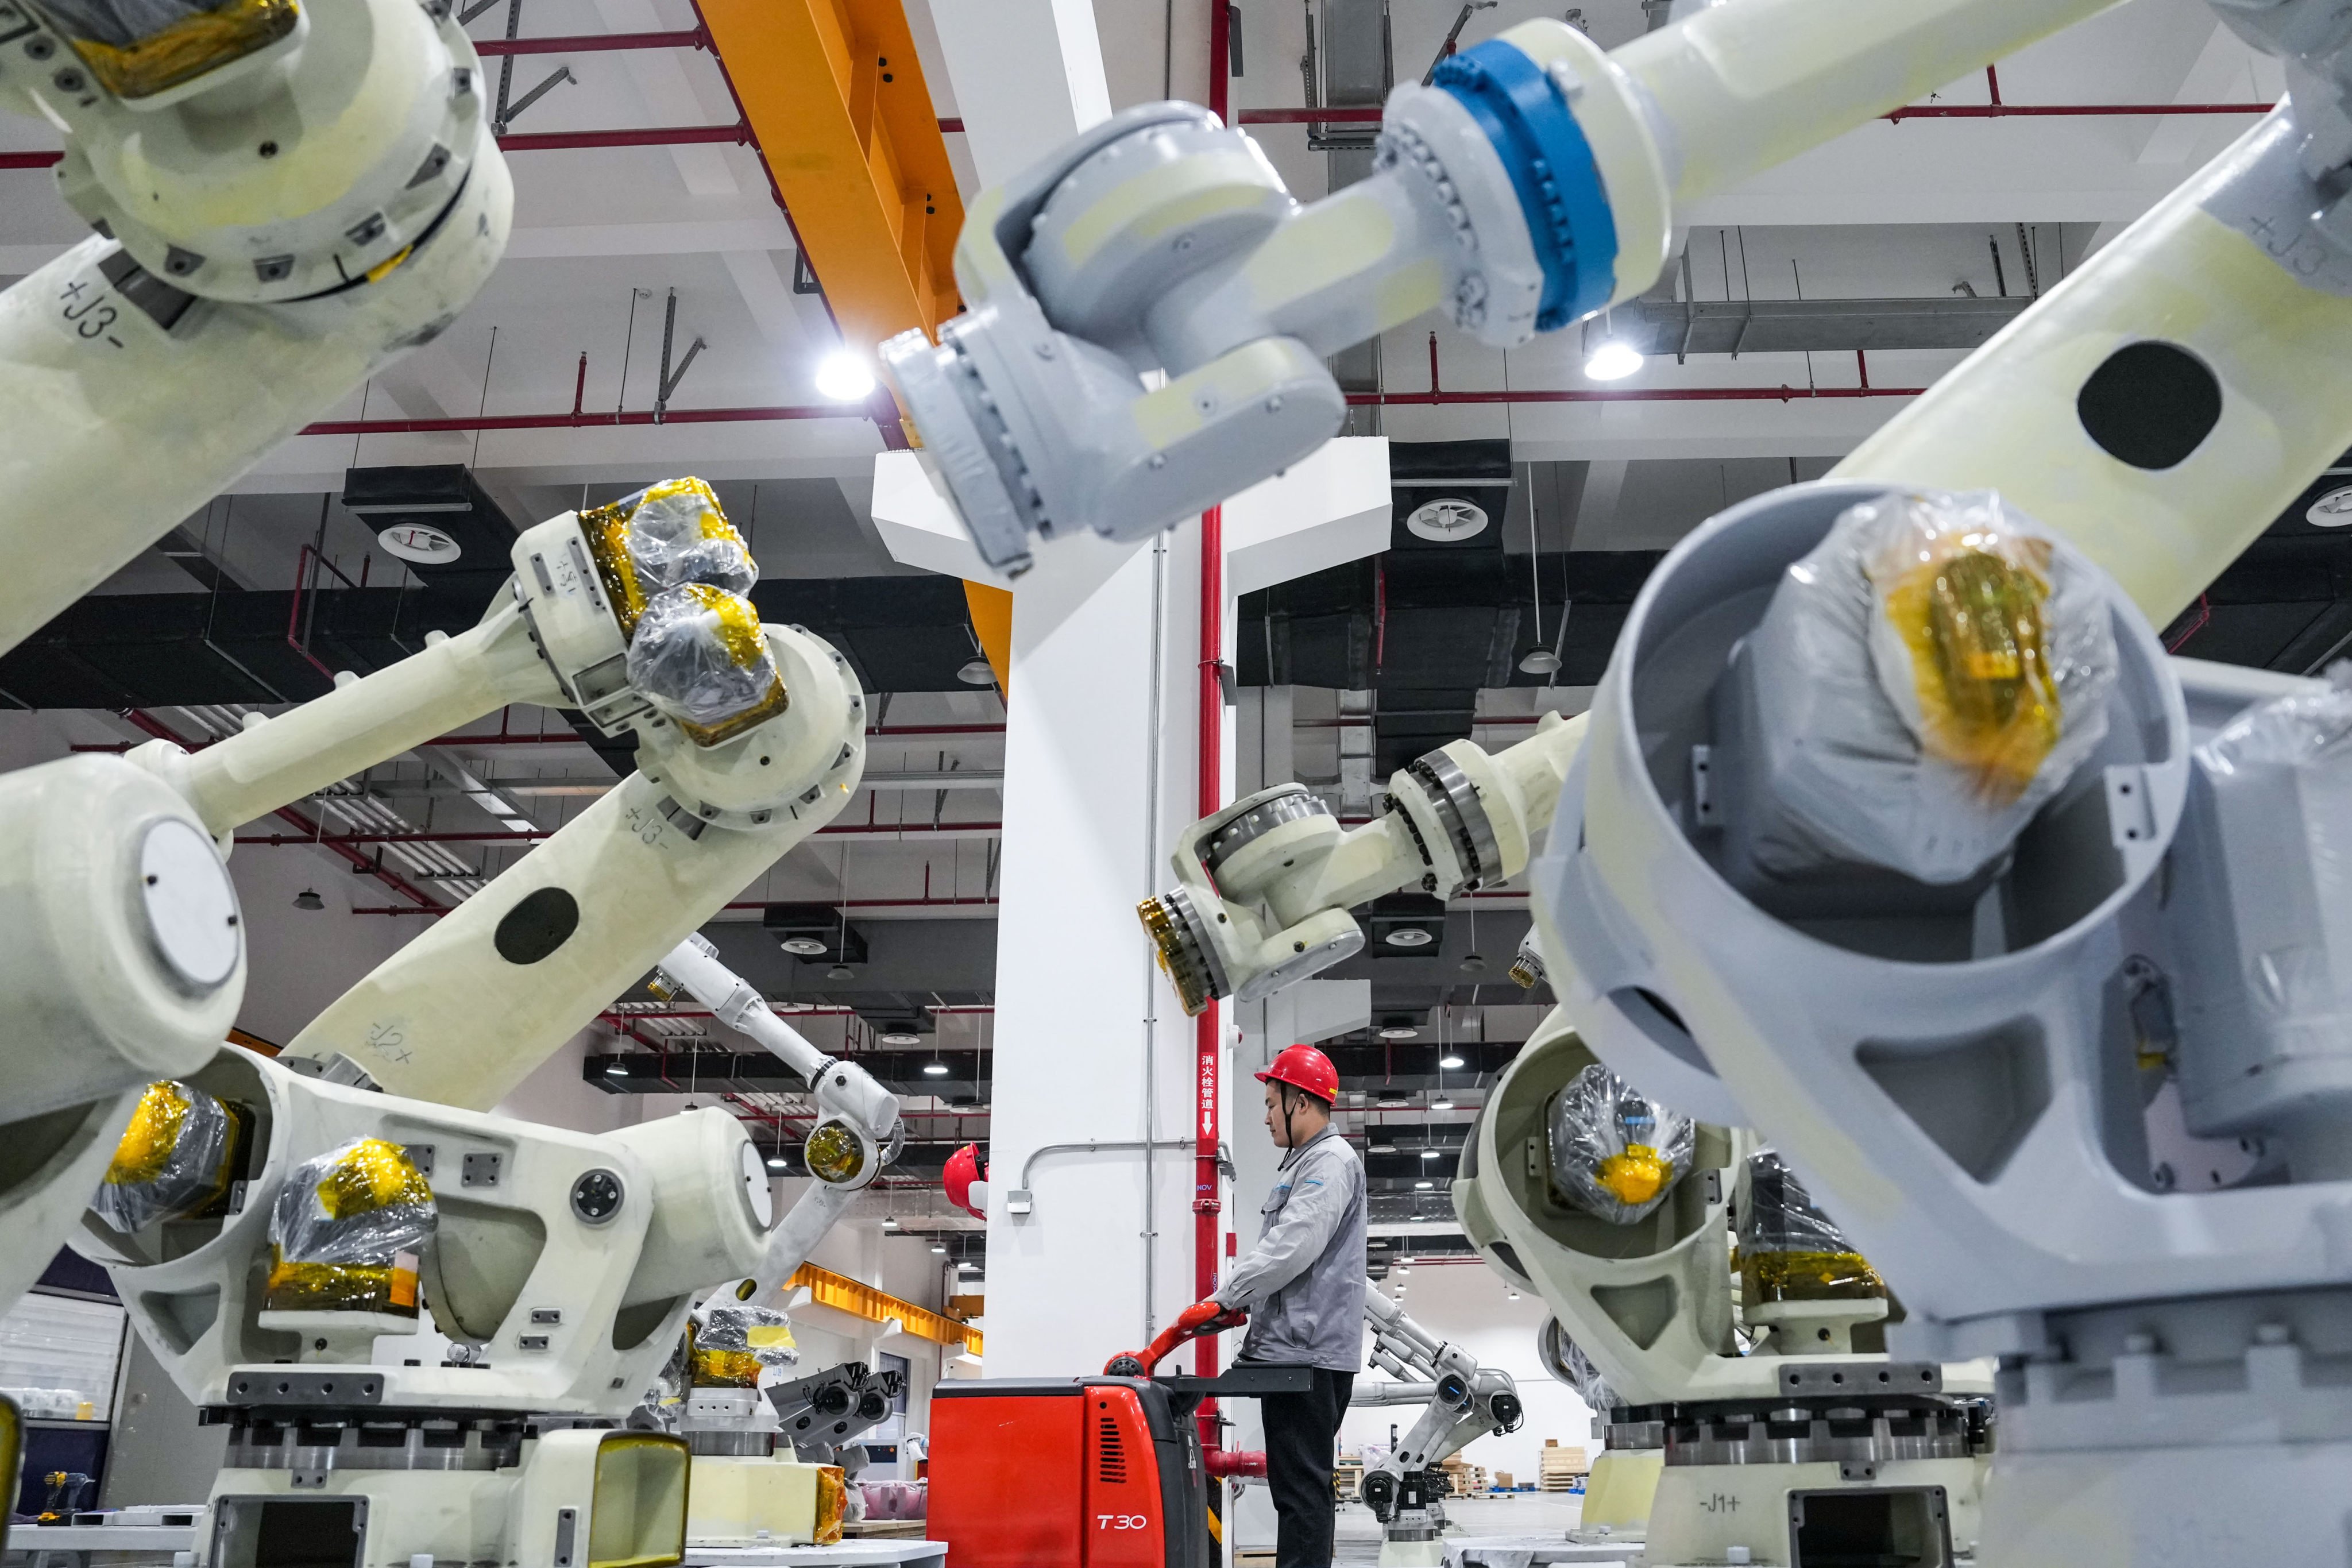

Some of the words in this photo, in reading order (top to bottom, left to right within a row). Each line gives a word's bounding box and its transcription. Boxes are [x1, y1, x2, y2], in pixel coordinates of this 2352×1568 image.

[60, 282, 123, 348] +J3-
[1202, 1055, 1214, 1109] 消火栓管道
[1700, 1493, 1741, 1513] -J1+
